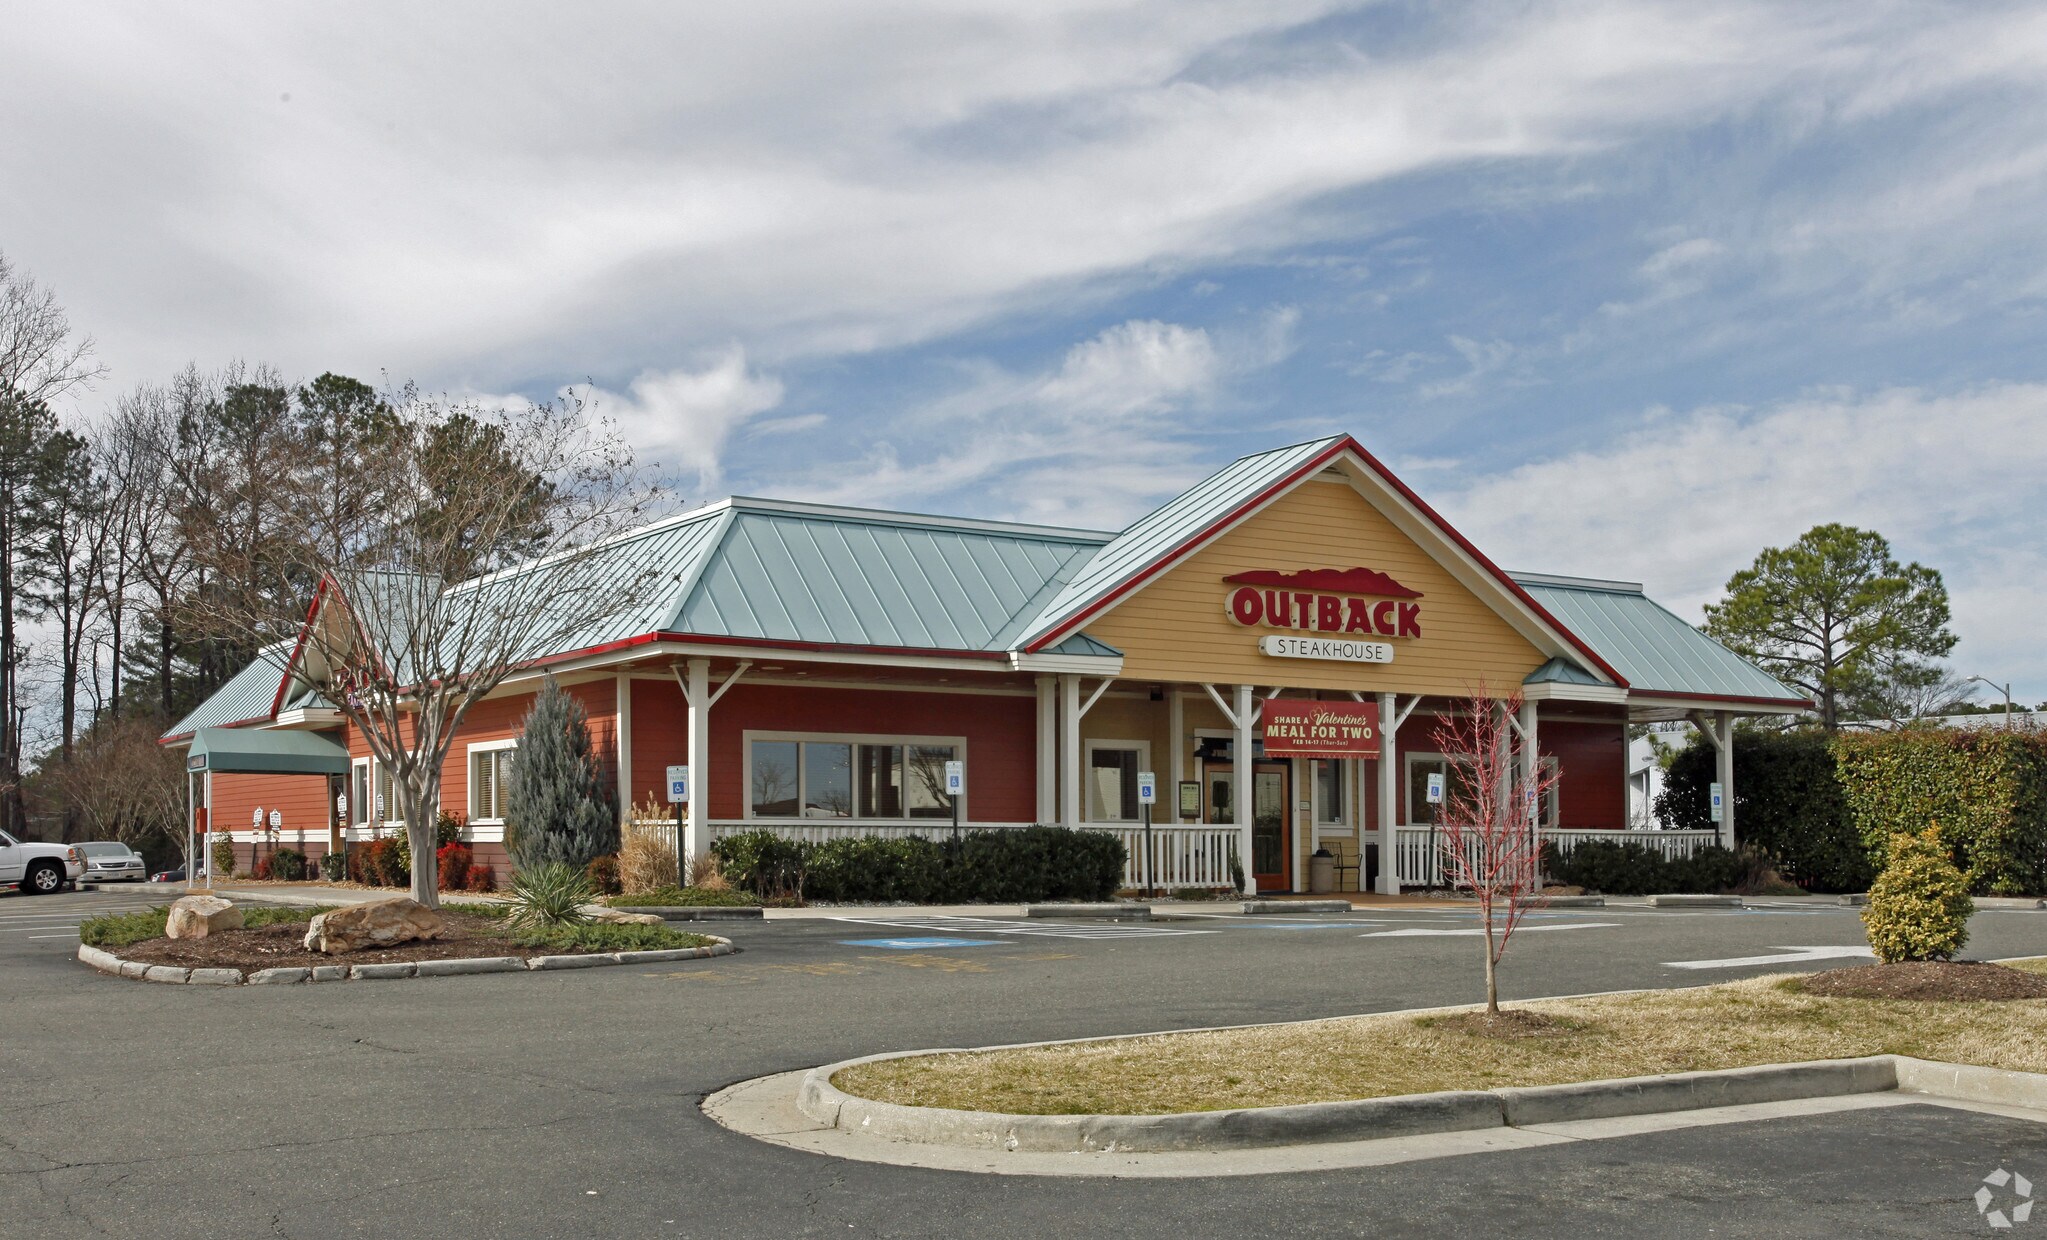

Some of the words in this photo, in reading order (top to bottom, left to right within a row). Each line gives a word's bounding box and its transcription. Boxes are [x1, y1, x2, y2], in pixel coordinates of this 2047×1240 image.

[1232, 587, 1421, 639] OUTBACK
[1277, 639, 1383, 660] STEAKHOUSE
[1274, 716, 1301, 724] SHARE
[1313, 711, 1368, 726] Valentine's
[1266, 725, 1306, 738] MEAL
[1311, 726, 1337, 738] FOR
[1341, 726, 1372, 739] TWO
